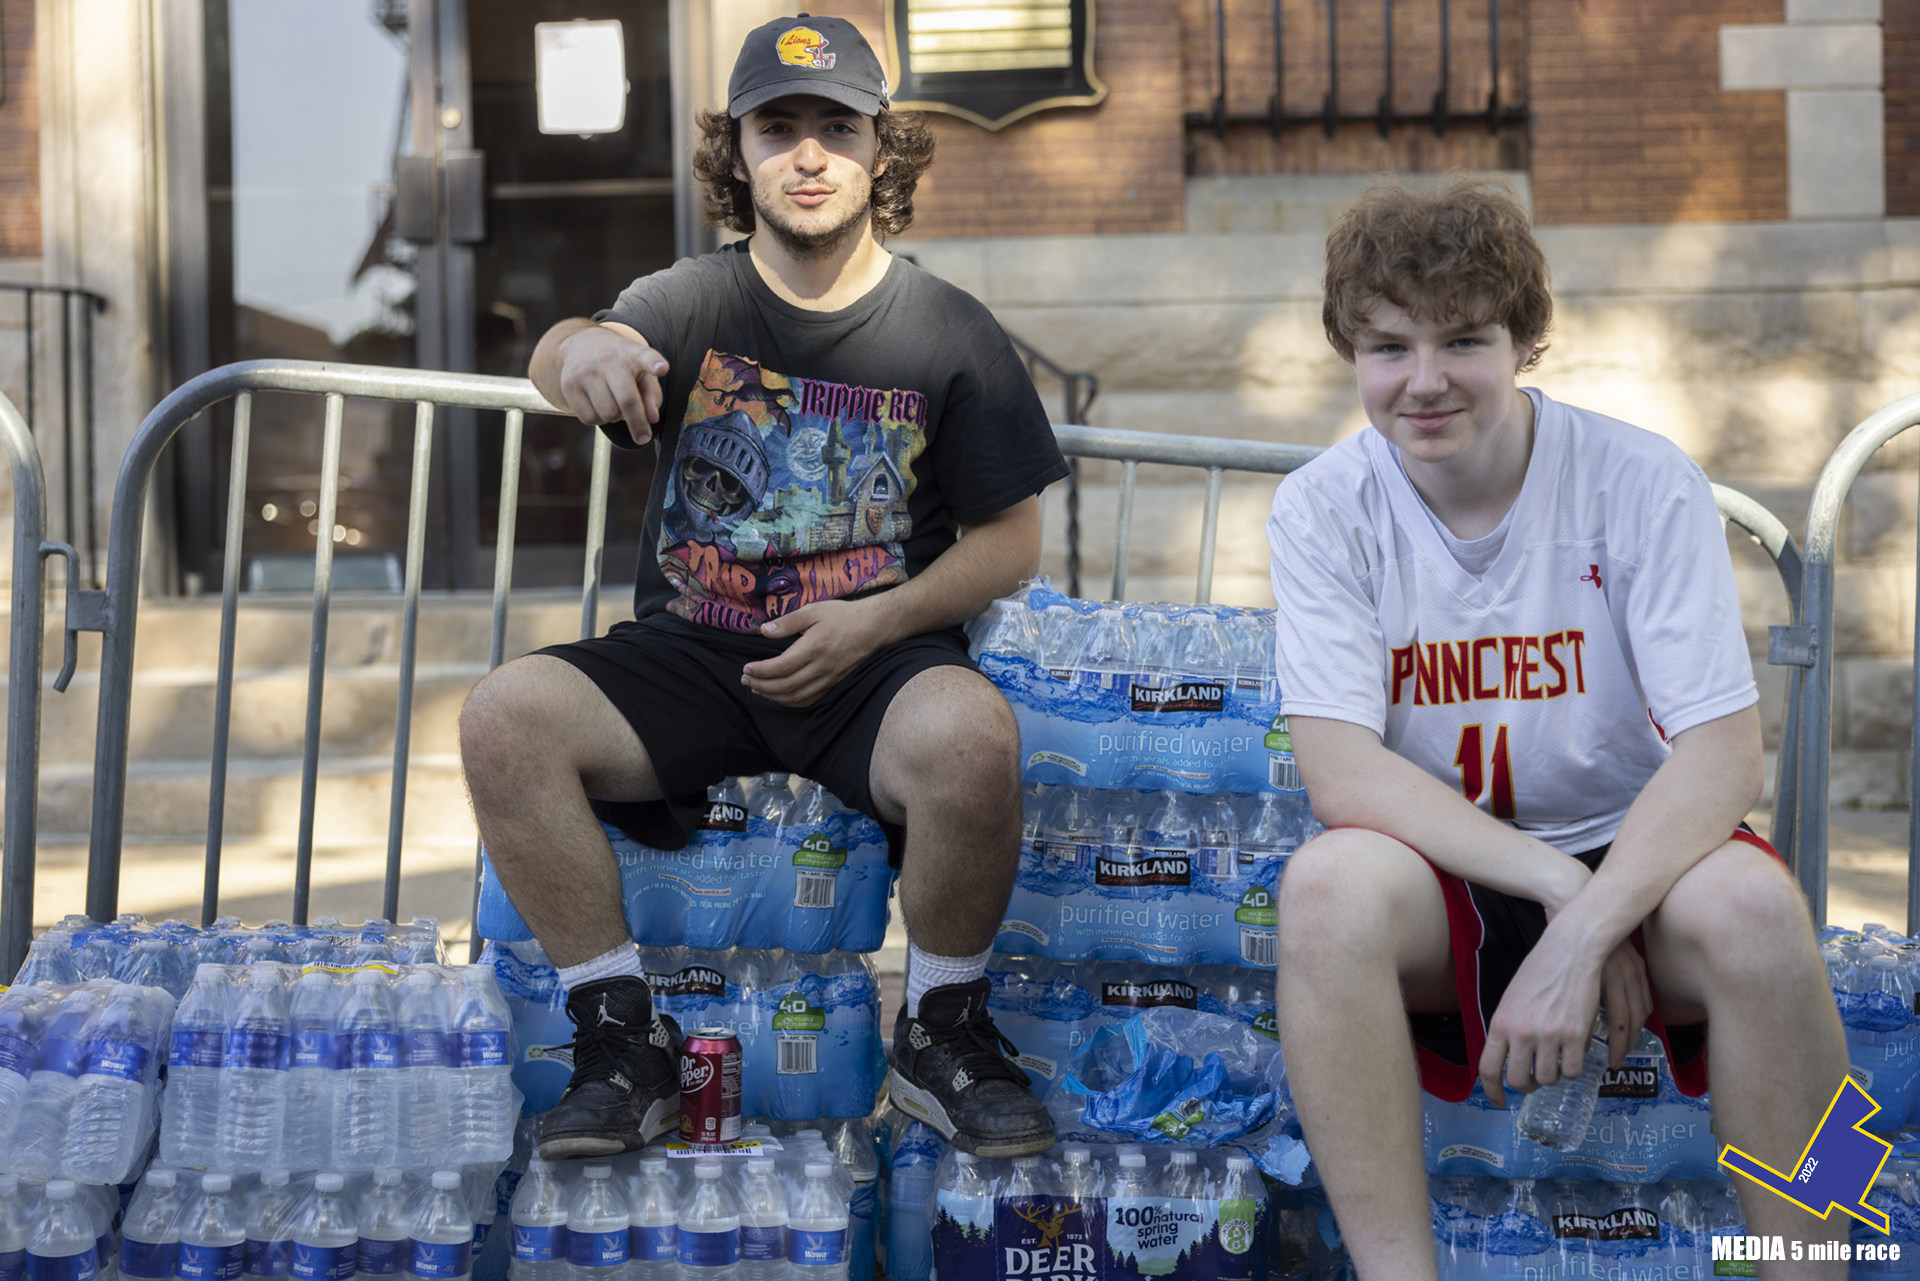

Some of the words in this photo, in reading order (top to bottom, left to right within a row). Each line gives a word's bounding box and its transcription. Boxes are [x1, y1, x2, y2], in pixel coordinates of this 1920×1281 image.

[784, 34, 811, 46] Lions
[799, 377, 886, 425] TRIPPIE
[687, 540, 757, 616] TRIP
[766, 592, 798, 619] AT
[1390, 629, 1586, 706] PNNCREST
[1135, 686, 1222, 702] KIRKLAND
[1135, 700, 1221, 713] Signature
[1099, 730, 1184, 756] purified
[1191, 735, 1254, 757] water
[1129, 755, 1170, 766] minerals
[1172, 758, 1201, 768] added
[1453, 723, 1517, 819] 11
[803, 839, 830, 852] 40
[713, 851, 782, 872] water
[1100, 860, 1188, 876] KIRKLAND
[624, 866, 647, 879] with
[650, 864, 692, 878] minerals
[694, 873, 722, 885] added
[724, 874, 736, 883] for
[741, 870, 765, 880] taste
[1100, 874, 1187, 887] Signature
[1243, 893, 1268, 907] 40
[1061, 904, 1149, 927] purified
[1159, 911, 1223, 930] water
[1075, 928, 1094, 936] with
[1096, 928, 1138, 939] minerals
[1140, 930, 1168, 941] added
[1170, 931, 1183, 942] for
[1185, 931, 1207, 943] taste
[1107, 983, 1194, 999] KIRKLAND
[780, 1001, 806, 1013] 40
[295, 1052, 318, 1060] Wawa
[373, 1053, 394, 1061] Wawa
[483, 1051, 503, 1059] Wawa
[102, 1059, 125, 1070] Wawa
[681, 1056, 697, 1073] Dr
[681, 1065, 710, 1088] pper.
[1603, 1070, 1655, 1086] LAND
[1623, 1122, 1698, 1148] water
[1603, 1149, 1635, 1159] added
[1115, 1206, 1162, 1227] 100%
[1154, 1211, 1203, 1225] natural
[1558, 1211, 1657, 1230] KIRKLAND
[1137, 1222, 1179, 1239] spring
[1138, 1233, 1179, 1250] water
[602, 1251, 623, 1260] Wawa
[804, 1250, 827, 1258] Wawa
[1004, 1244, 1096, 1274] DEER
[181, 1262, 203, 1273] Wawa
[293, 1262, 314, 1273] Wawa
[415, 1260, 438, 1271] Wawa
[1524, 1256, 1623, 1281] purified
[1631, 1265, 1703, 1281] water
